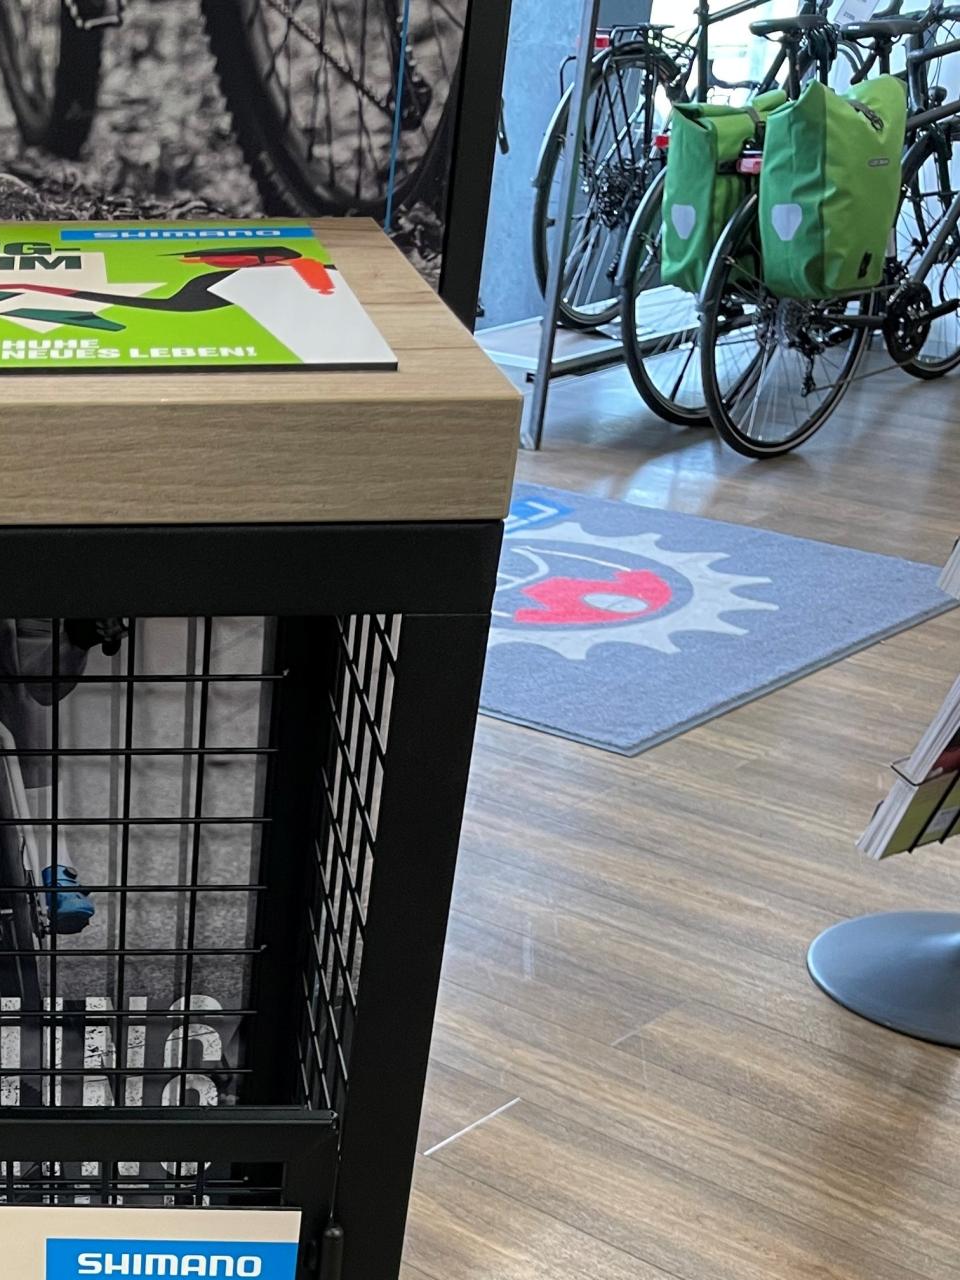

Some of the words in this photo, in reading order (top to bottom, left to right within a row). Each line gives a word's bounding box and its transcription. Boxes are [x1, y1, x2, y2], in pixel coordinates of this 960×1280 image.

[93, 230, 282, 239] SHIMANO
[2, 348, 121, 360] NEUES
[130, 346, 258, 359] LEBEN!
[77, 1252, 262, 1277] SHIMANO
